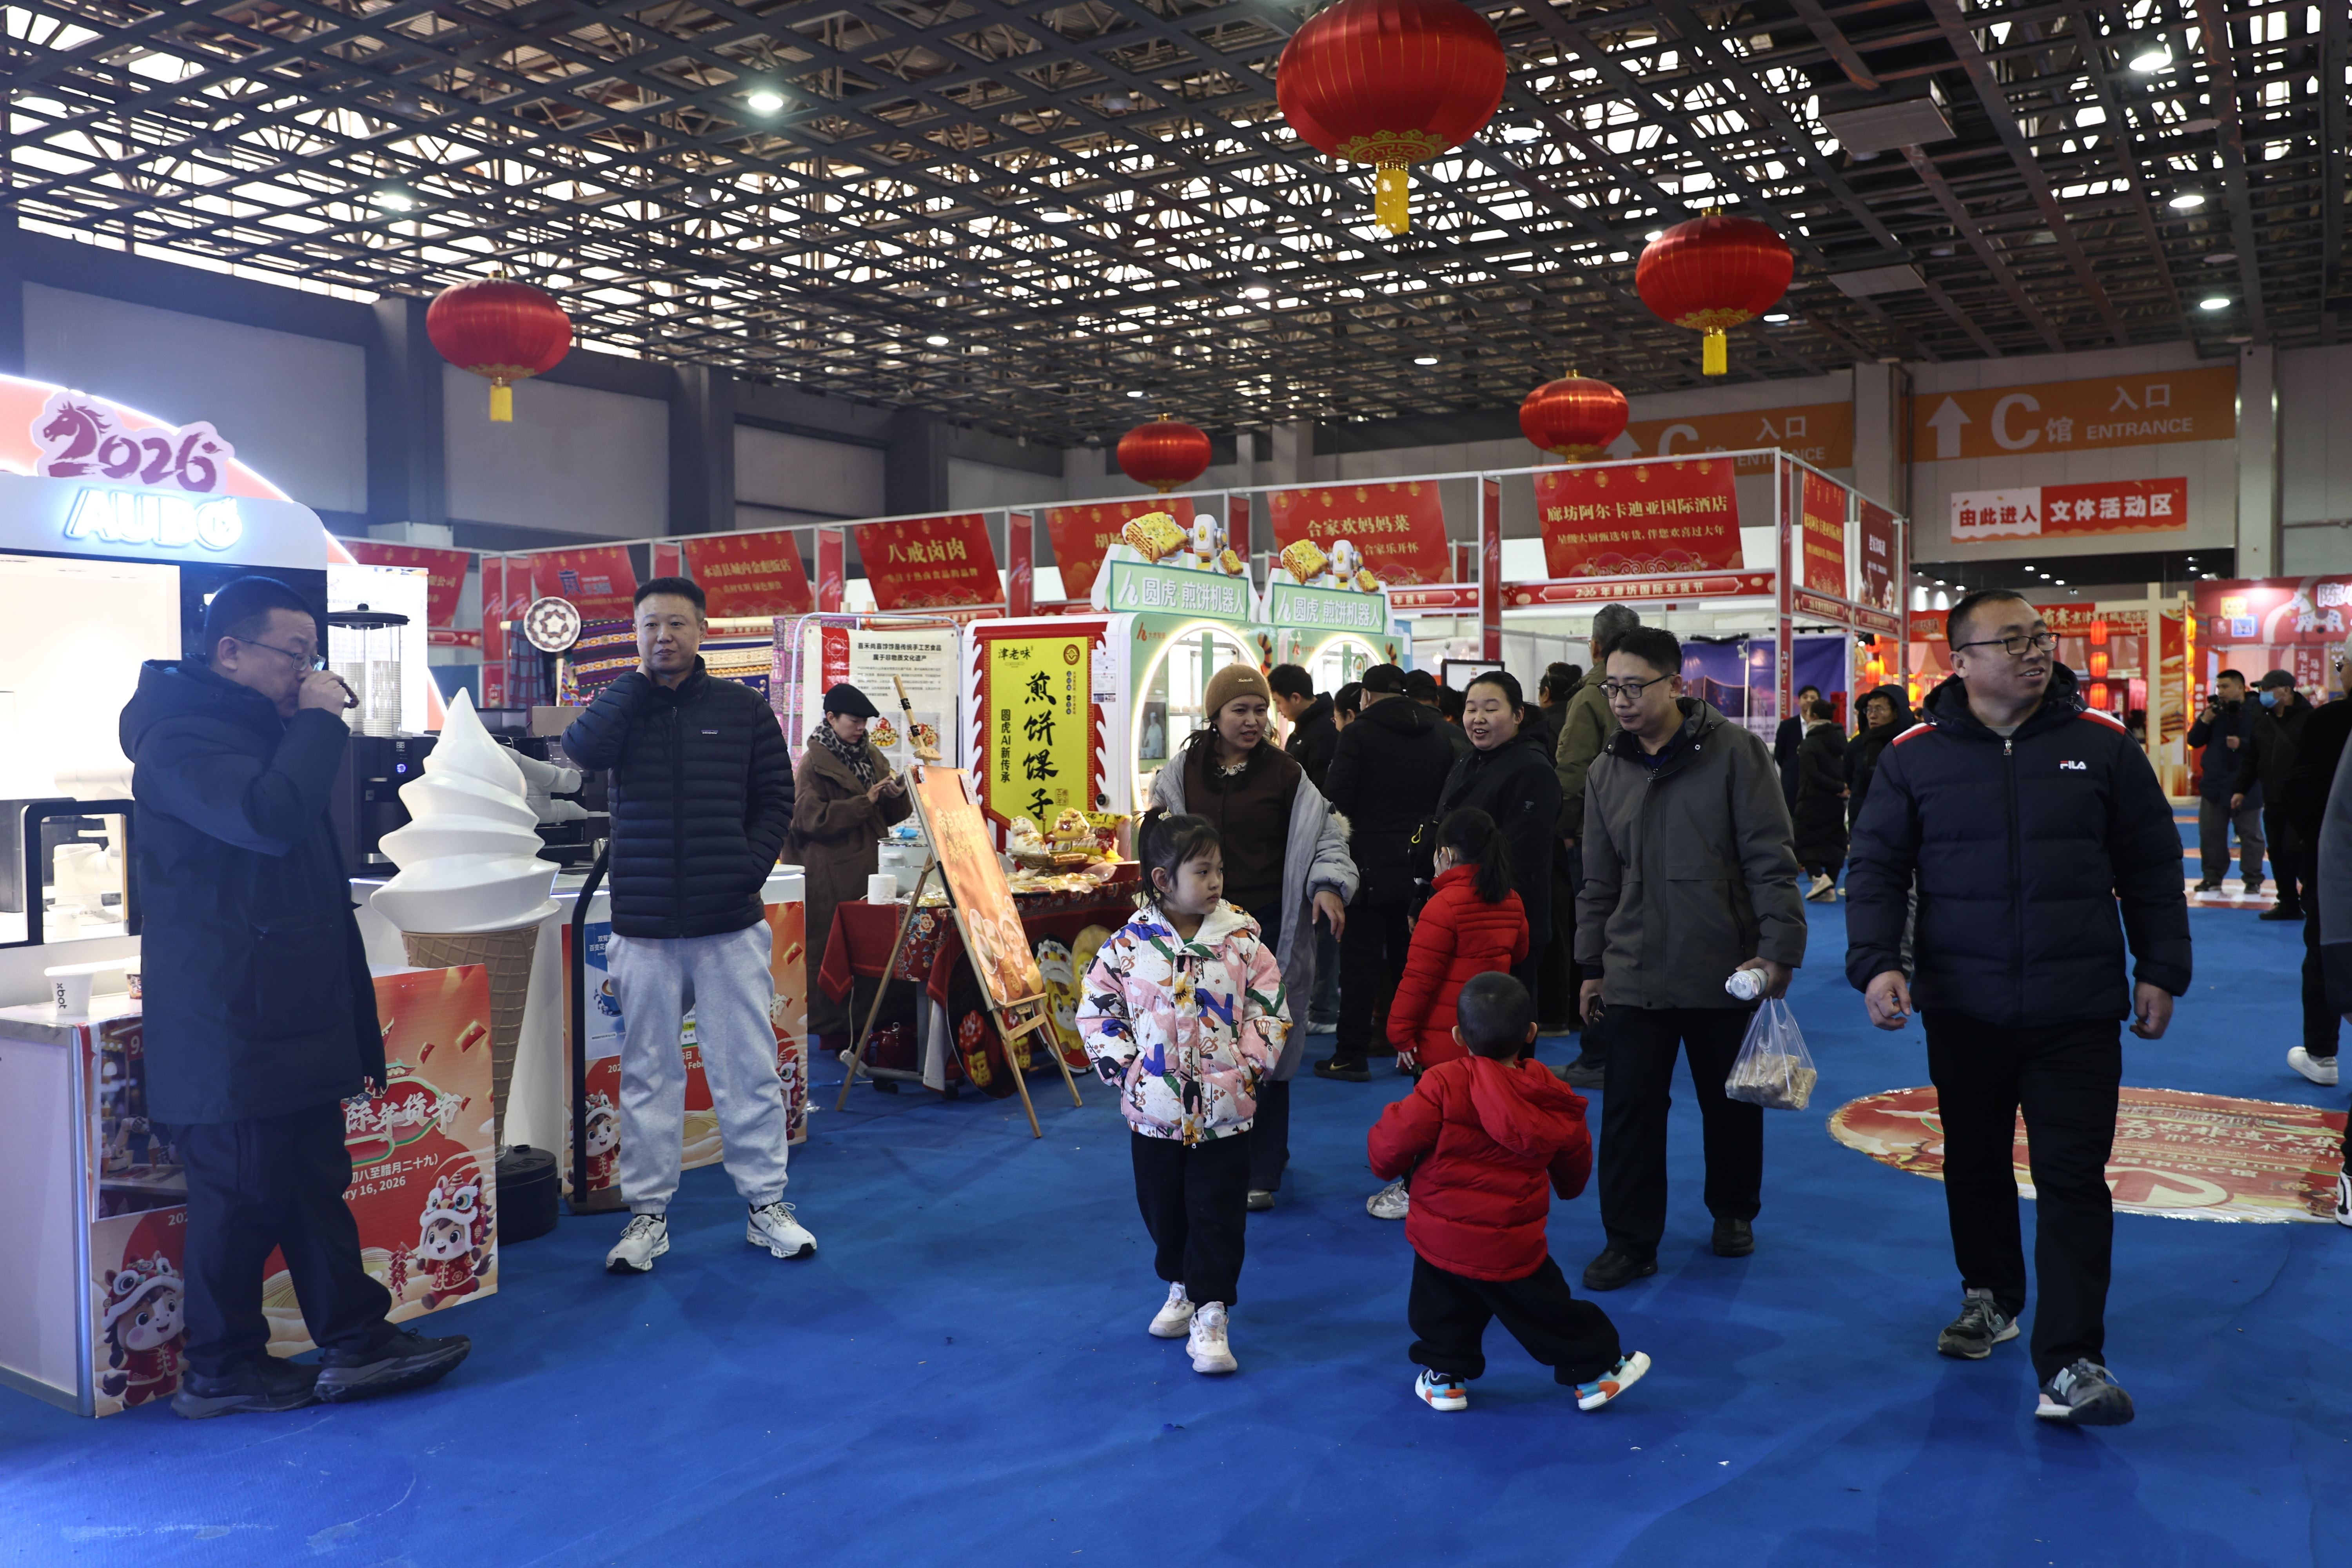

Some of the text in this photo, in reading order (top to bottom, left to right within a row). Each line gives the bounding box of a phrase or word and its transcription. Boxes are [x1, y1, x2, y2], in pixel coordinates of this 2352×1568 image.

[2109, 385, 2171, 412] 入口
[1757, 416, 1806, 442] 入口
[2086, 417, 2193, 441] ENTRANCE
[1547, 495, 1728, 523] 廊坊阿尔卡迪亚国际酒店
[1960, 505, 2037, 526] 由此进入
[2049, 493, 2173, 521] 文体活动区
[1307, 514, 1410, 537] 合家欢妈妈菜
[889, 537, 967, 563] 八戒卤肉
[1142, 577, 1245, 614] 圆虎·煎饼机器人
[1294, 597, 1381, 628] 圆虎·煎饼机器人
[998, 646, 1031, 660] 津老味
[2060, 760, 2086, 769] FILA
[589, 943, 607, 951] 百变花
[56, 982, 67, 1009] xbot
[608, 1063, 621, 1074] 202
[360, 1184, 377, 1195] 16,
[380, 1176, 406, 1191] 2026
[168, 1212, 188, 1226] 202
